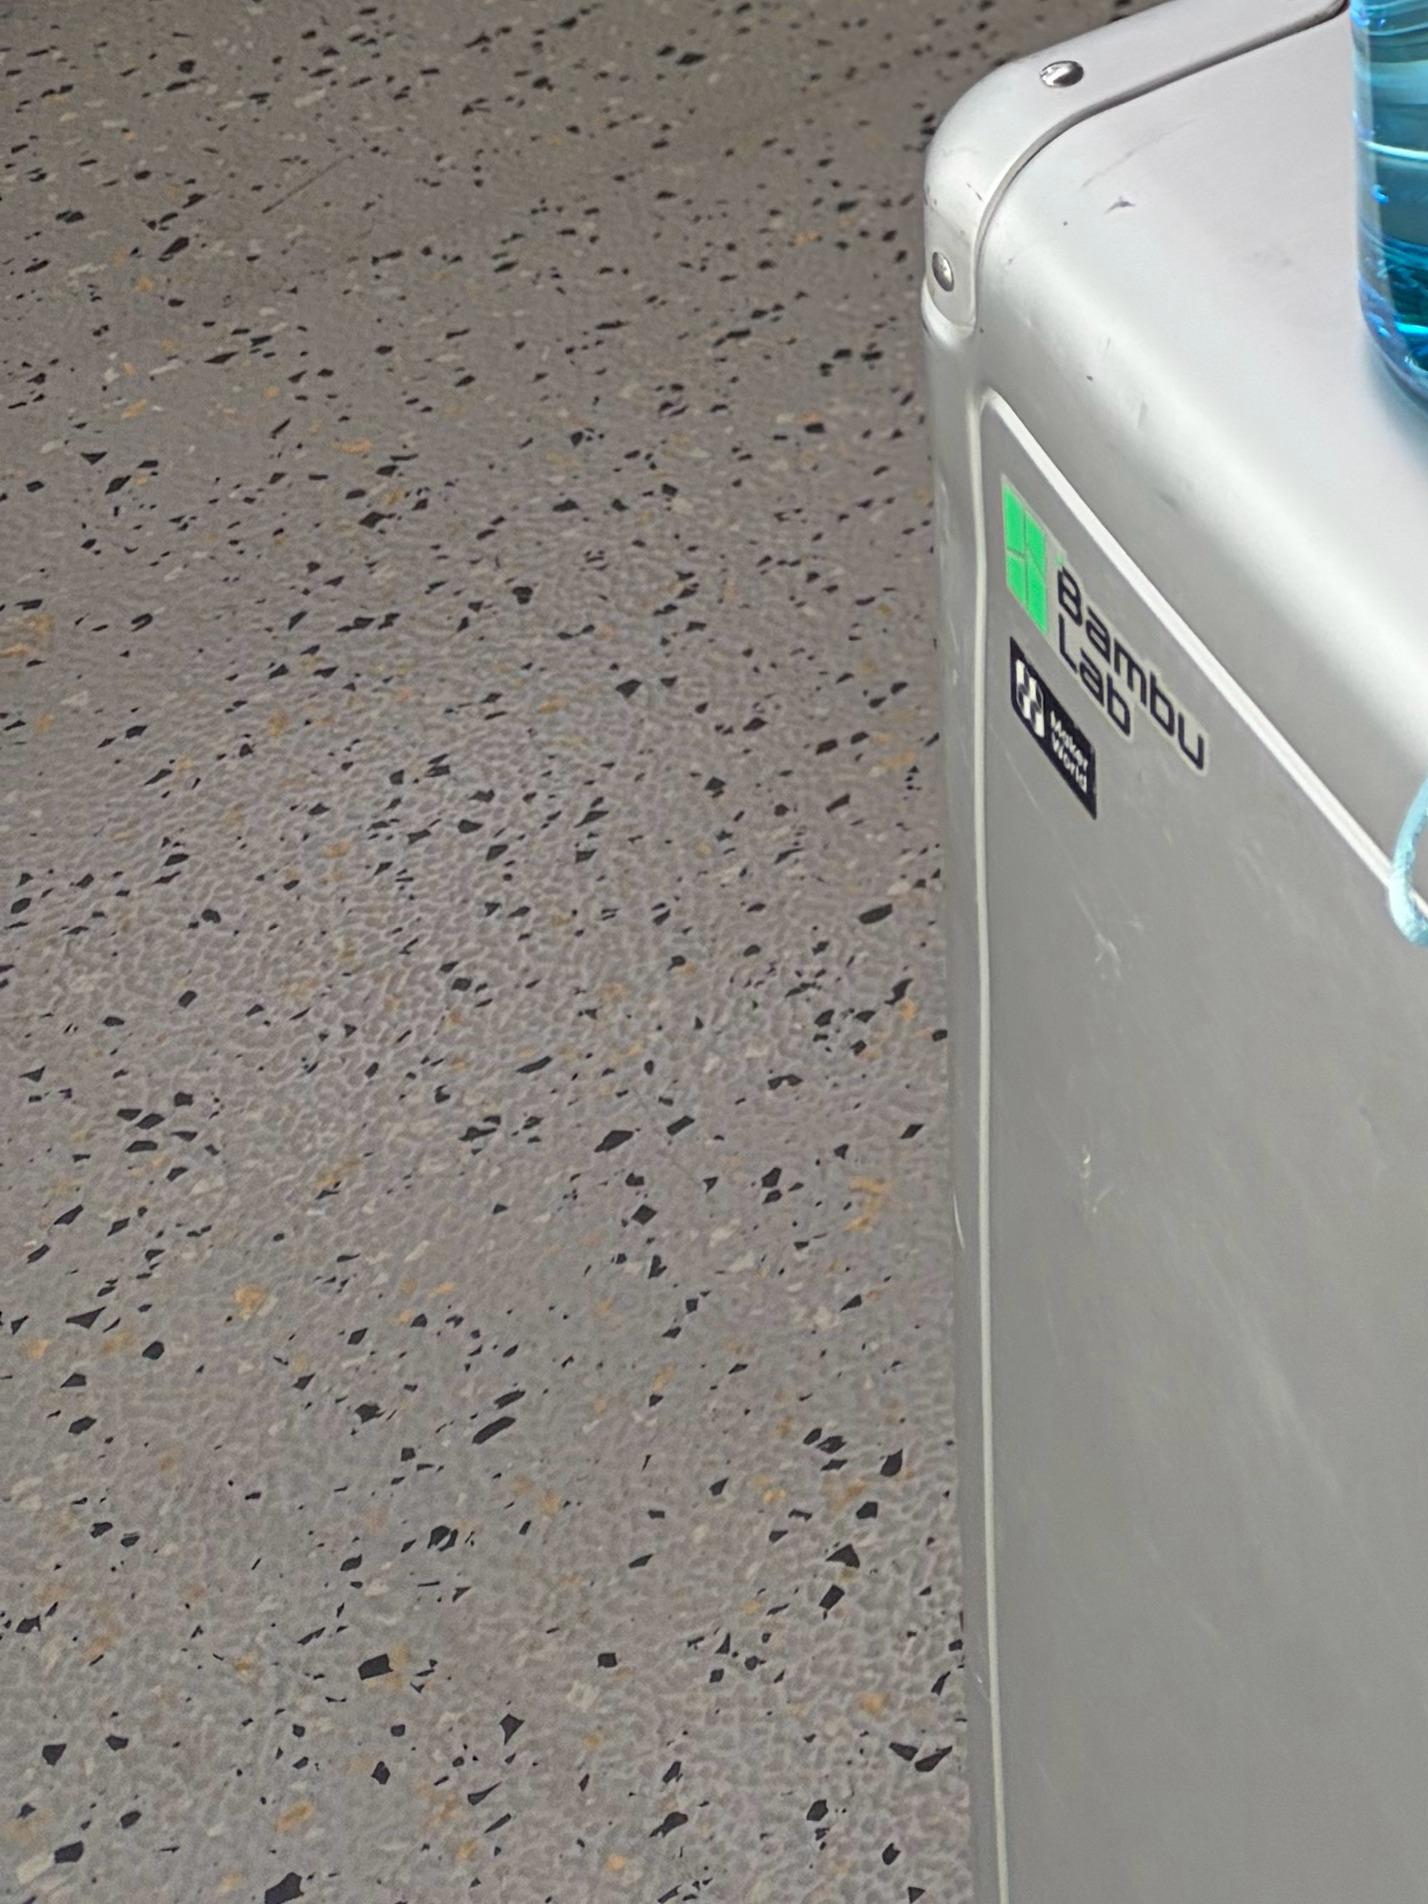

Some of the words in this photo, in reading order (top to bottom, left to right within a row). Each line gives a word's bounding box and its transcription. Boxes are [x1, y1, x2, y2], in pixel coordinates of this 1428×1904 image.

[1056, 565, 1205, 771] Bambu
[1057, 613, 1132, 737] Lab
[1050, 710, 1089, 772] Maker
[1051, 731, 1088, 794] World
